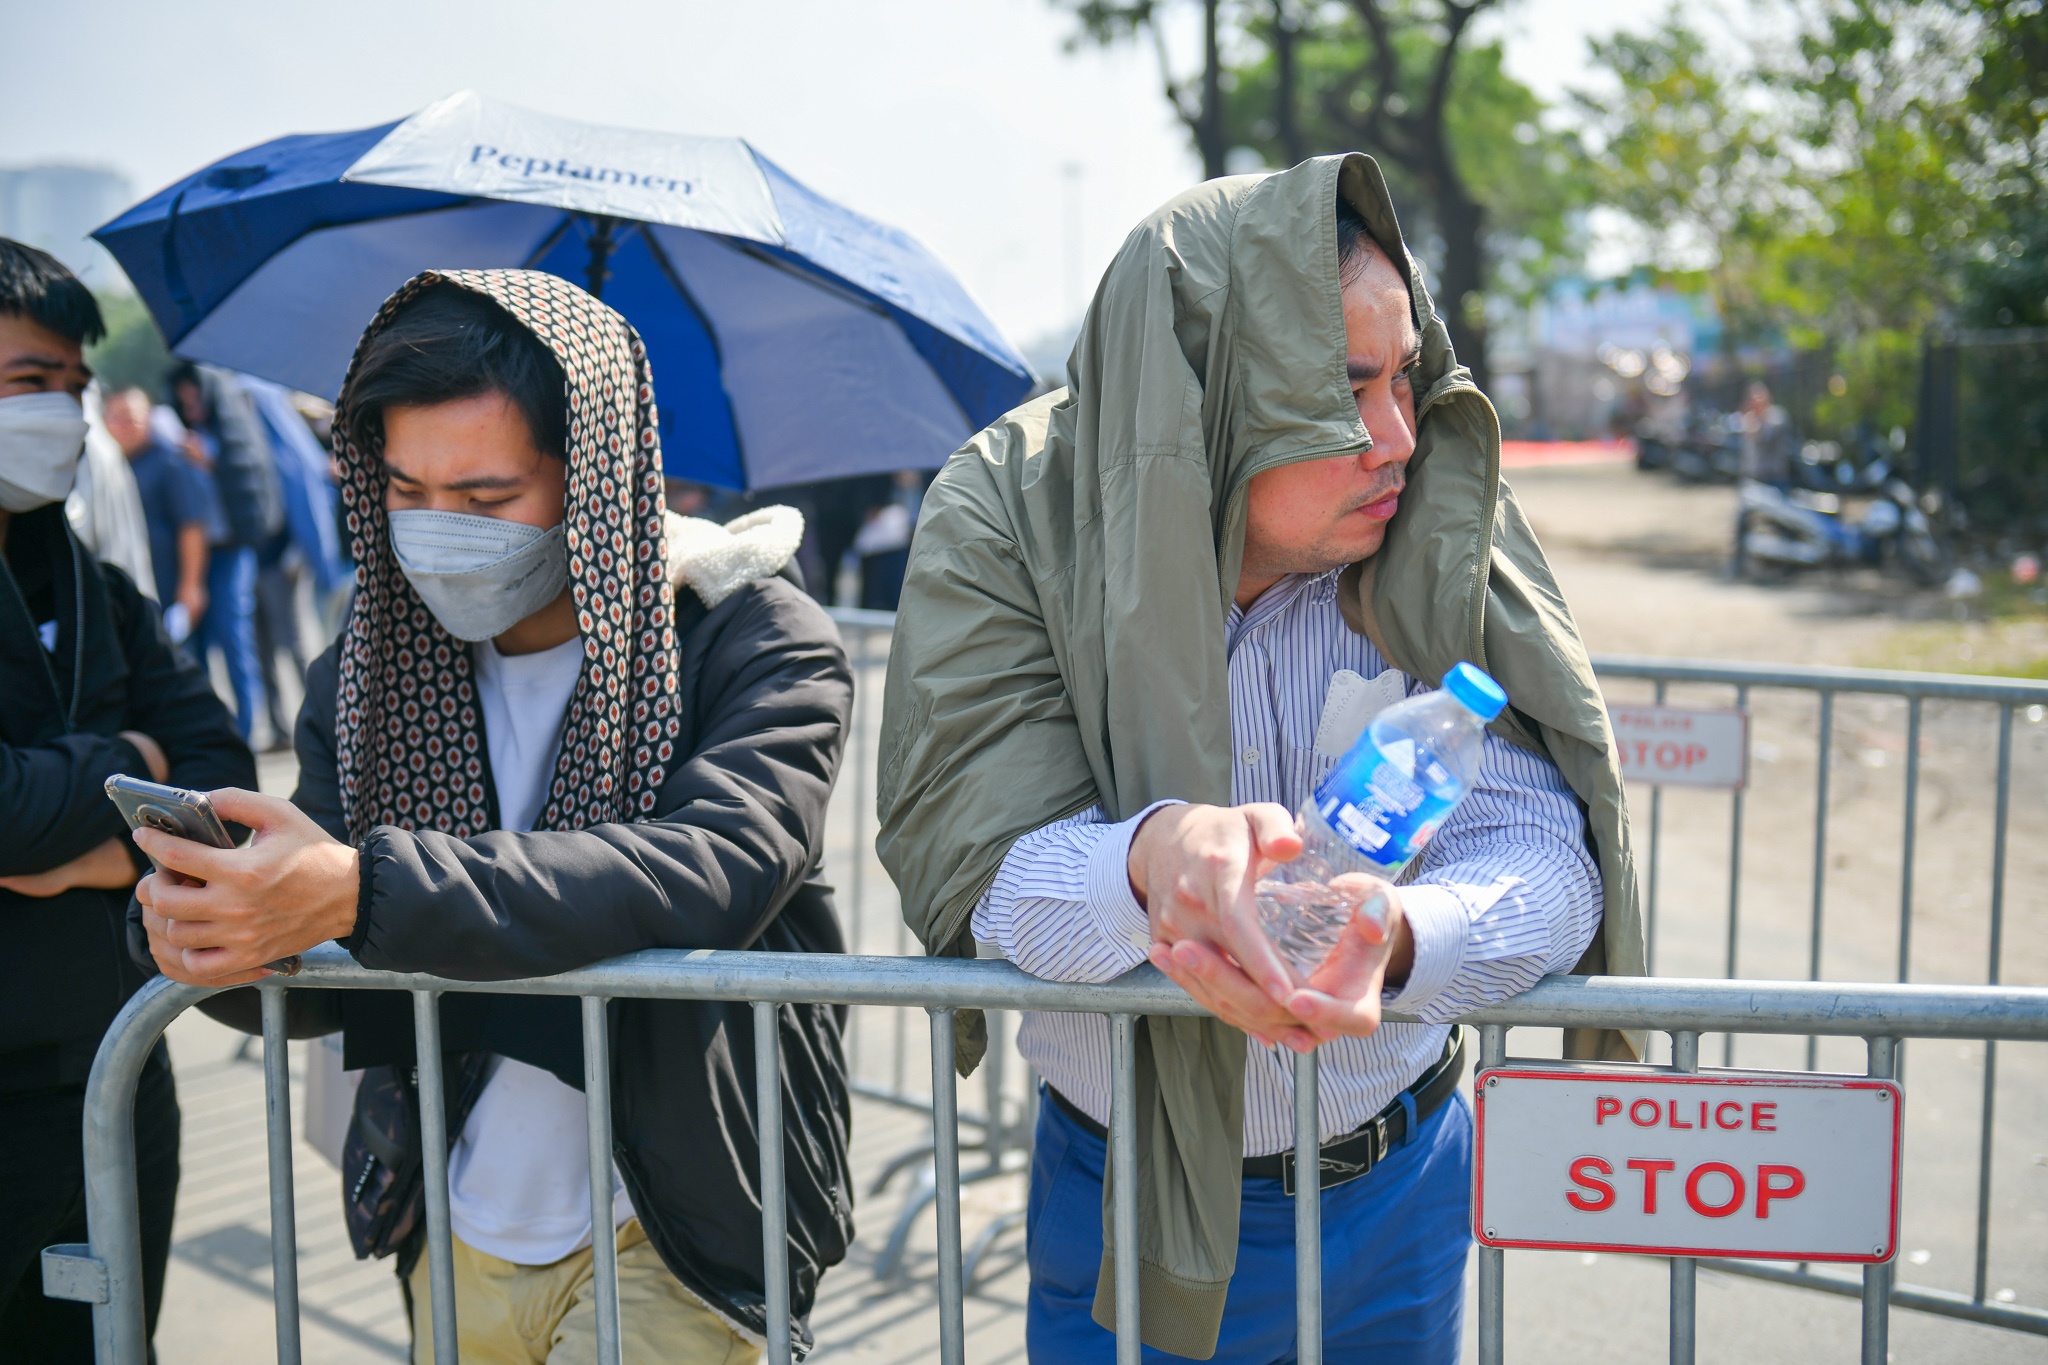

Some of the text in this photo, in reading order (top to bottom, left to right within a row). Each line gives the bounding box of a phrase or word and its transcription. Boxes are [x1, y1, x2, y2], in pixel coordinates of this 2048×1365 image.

[470, 144, 693, 195] Peptamen
[1596, 1096, 1778, 1132] POLICE
[1565, 1156, 1807, 1219] STOP
